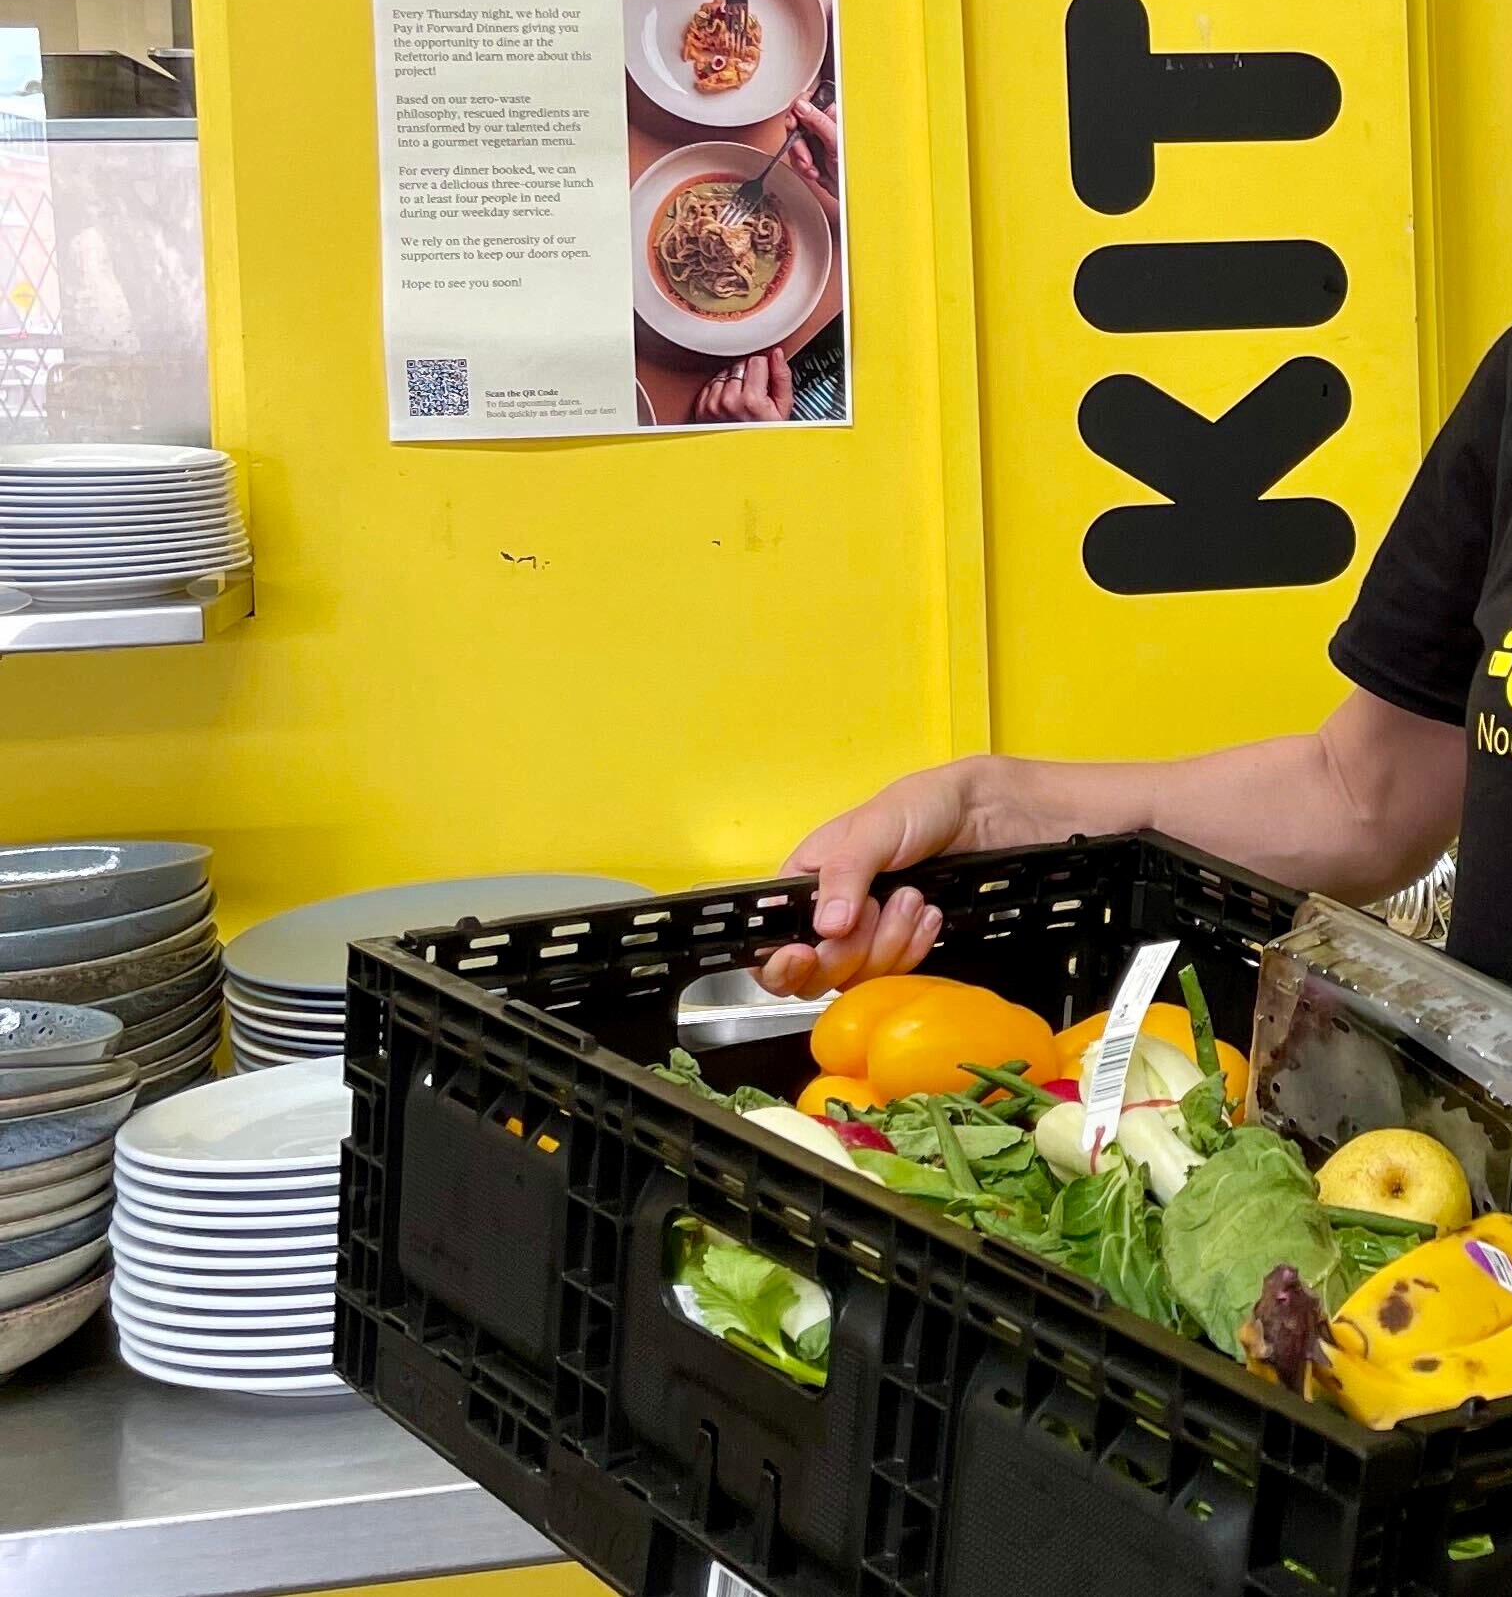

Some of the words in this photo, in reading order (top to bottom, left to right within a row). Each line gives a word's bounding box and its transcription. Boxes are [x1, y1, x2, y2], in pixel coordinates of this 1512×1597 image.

[393, 10, 424, 20] Every
[427, 9, 479, 20] Thursday
[481, 9, 513, 19] night,
[536, 9, 558, 18] hold
[393, 24, 413, 35] Pay
[427, 24, 473, 33] Forward
[477, 24, 518, 33] Dinners
[522, 24, 555, 35] giving
[559, 25, 579, 34] you
[394, 38, 411, 48] the
[414, 38, 479, 49] opportunity
[482, 38, 493, 47] to
[497, 37, 520, 47] dine
[536, 37, 553, 47] the
[395, 52, 449, 62] Refettorio
[452, 51, 472, 61] and
[476, 51, 503, 61] learn
[506, 53, 534, 61] more
[538, 51, 568, 61] about
[571, 51, 591, 61] this
[395, 66, 436, 78] project!
[396, 95, 428, 105] Based
[470, 95, 531, 104] zero-waste
[397, 109, 460, 121] philosophy,
[464, 109, 505, 118] rescued
[509, 108, 569, 119] ingredients
[397, 123, 465, 133] transformed
[469, 123, 481, 134] by
[484, 124, 503, 132] our
[506, 123, 549, 132] talented
[553, 122, 581, 132] chefs
[398, 137, 420, 147] into
[423, 139, 429, 147] a
[432, 138, 478, 149] gourmet
[482, 137, 539, 148] vegetarian
[542, 138, 576, 146] menu.
[399, 166, 417, 176] For
[420, 168, 450, 177] every
[453, 166, 489, 175] dinner
[492, 165, 535, 175] booked,
[538, 166, 554, 174] we
[557, 166, 576, 174] can
[399, 182, 428, 190] serve
[441, 179, 488, 189] delicious
[492, 179, 560, 189] three-course
[563, 178, 594, 188] lunch
[400, 195, 411, 204] to
[414, 195, 424, 204] at
[427, 194, 452, 204] least
[456, 194, 478, 203] four
[481, 193, 518, 205] people
[521, 193, 531, 203] in
[534, 193, 560, 202] need
[400, 209, 436, 220] during
[440, 210, 458, 218] our
[462, 208, 509, 219] weekday
[512, 208, 553, 217] service.
[401, 237, 419, 246] We
[423, 237, 442, 247] rely
[463, 236, 480, 245] the
[483, 236, 540, 246] generosity
[543, 235, 554, 244] of
[557, 236, 576, 244] our
[401, 251, 460, 262] supporters
[463, 251, 474, 259] to
[477, 250, 502, 261] keep
[506, 251, 524, 259] our
[528, 249, 558, 259] doors
[561, 250, 591, 259] open.
[402, 280, 431, 291] Hope
[434, 280, 445, 288] to
[469, 280, 489, 289] you
[493, 278, 522, 287] soon!
